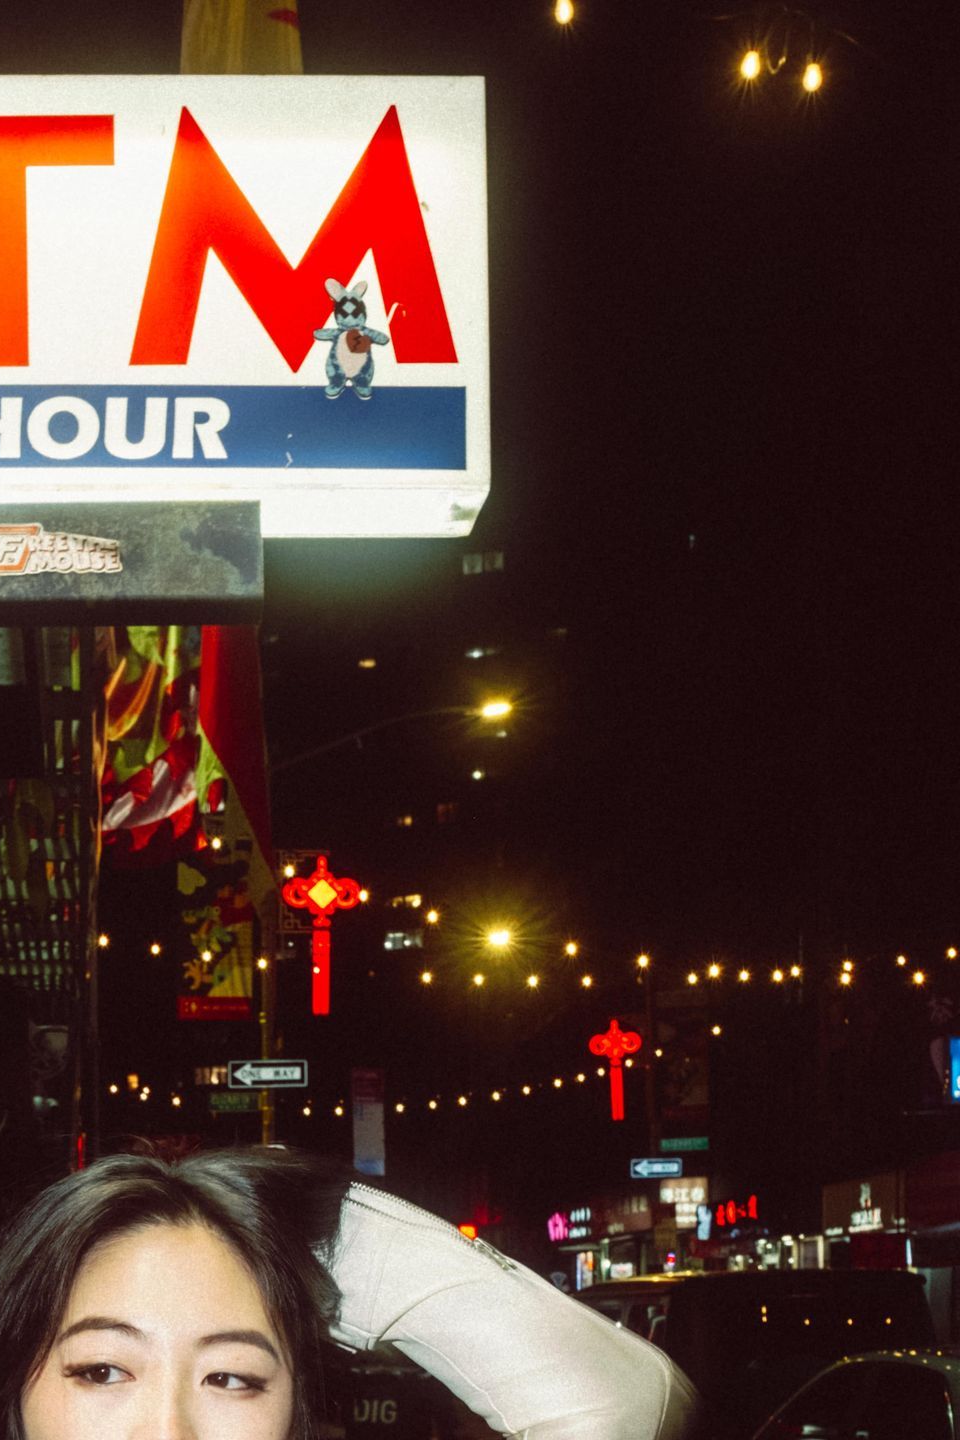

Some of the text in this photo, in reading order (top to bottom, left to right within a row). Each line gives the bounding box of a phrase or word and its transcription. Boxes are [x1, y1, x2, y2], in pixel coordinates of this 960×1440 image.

[29, 550, 121, 572] MOUSE
[241, 1069, 297, 1080] ONE WAY
